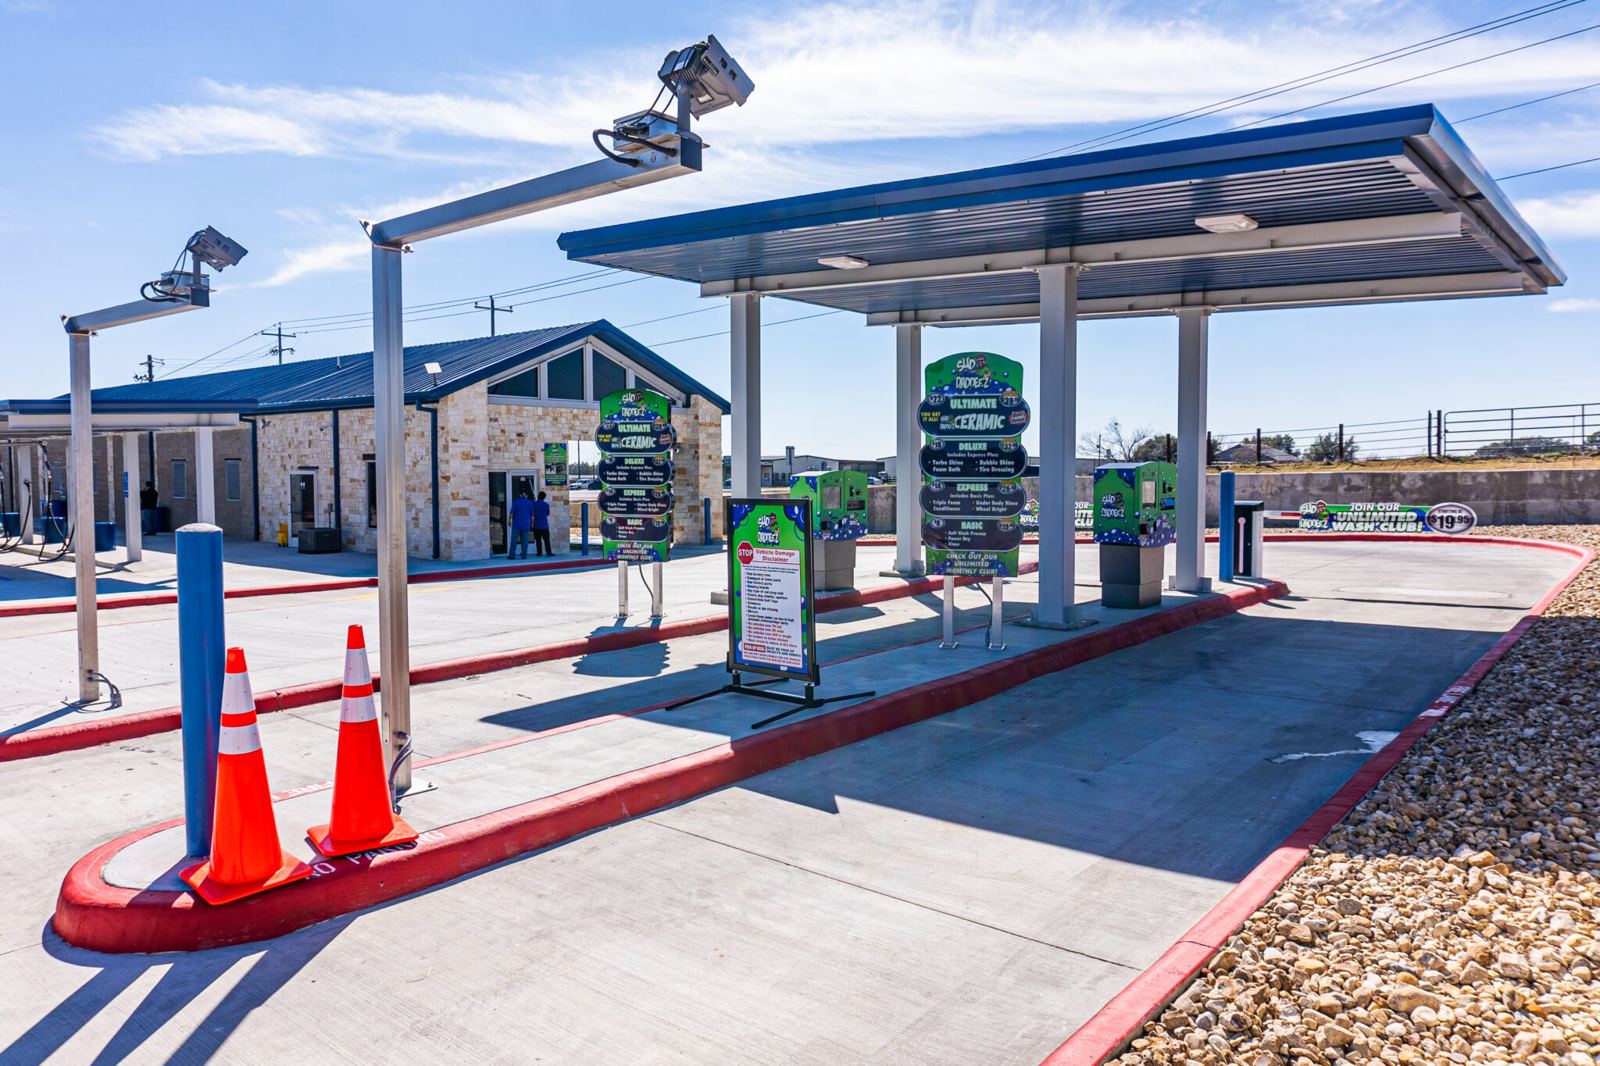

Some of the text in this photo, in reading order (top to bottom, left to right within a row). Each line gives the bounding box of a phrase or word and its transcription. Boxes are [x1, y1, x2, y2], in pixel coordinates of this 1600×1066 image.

[950, 398, 998, 409] ULTIMATE
[954, 413, 1006, 430] CERAMIC
[618, 424, 651, 432] ULTIMATE
[621, 436, 657, 449] CERAMIC
[958, 442, 988, 451] DELUXE
[956, 484, 989, 492] EXPRESS
[1350, 502, 1400, 511] JOIN OUR
[1336, 512, 1417, 522] UNLIMITED
[961, 521, 983, 530] BASIC
[1075, 518, 1093, 526] CLU
[1332, 522, 1423, 531] WASH CLUB!
[1431, 515, 1470, 529] $19.95
